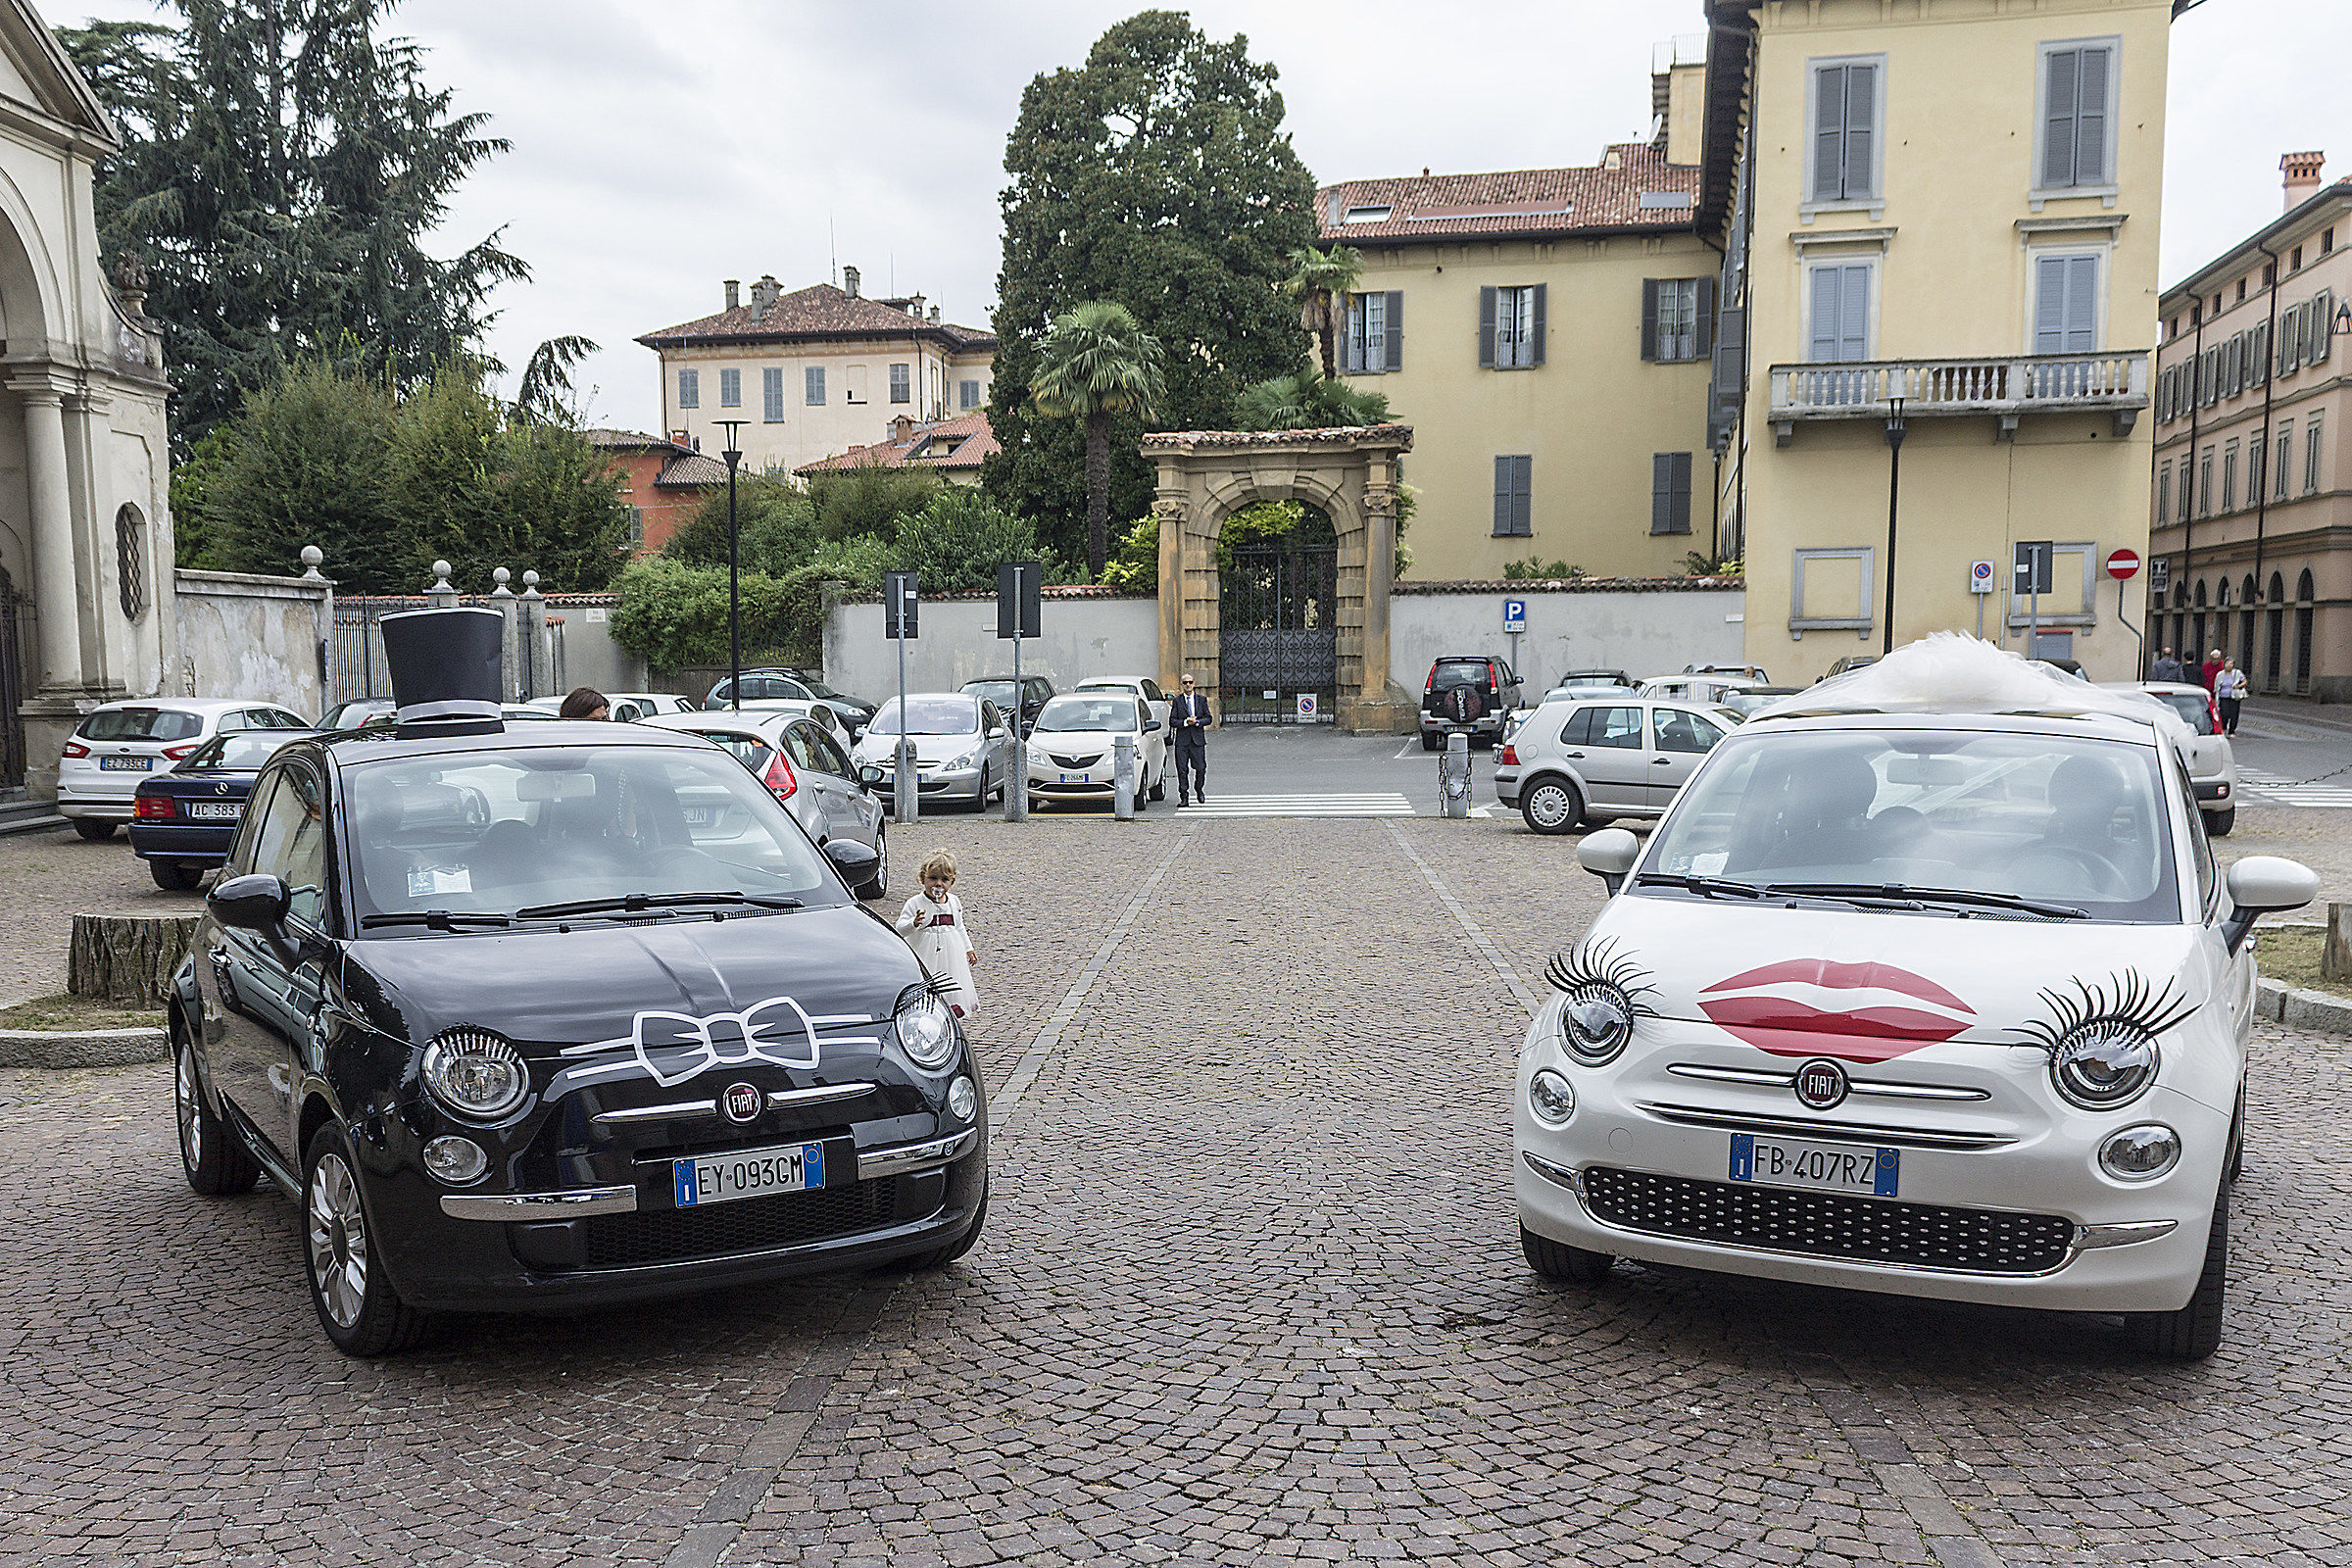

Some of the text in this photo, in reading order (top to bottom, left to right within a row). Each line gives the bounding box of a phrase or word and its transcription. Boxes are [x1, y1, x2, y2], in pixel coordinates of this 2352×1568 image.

[1508, 603, 1522, 620] P
[194, 805, 209, 816] AC
[214, 805, 235, 816] 383
[1808, 1074, 1835, 1096] FIAT
[731, 1093, 754, 1113] FIAT
[697, 1163, 725, 1196] EY
[734, 1153, 804, 1191] 093GM
[1753, 1144, 1785, 1175] FB
[1793, 1149, 1875, 1186] 407RZ
